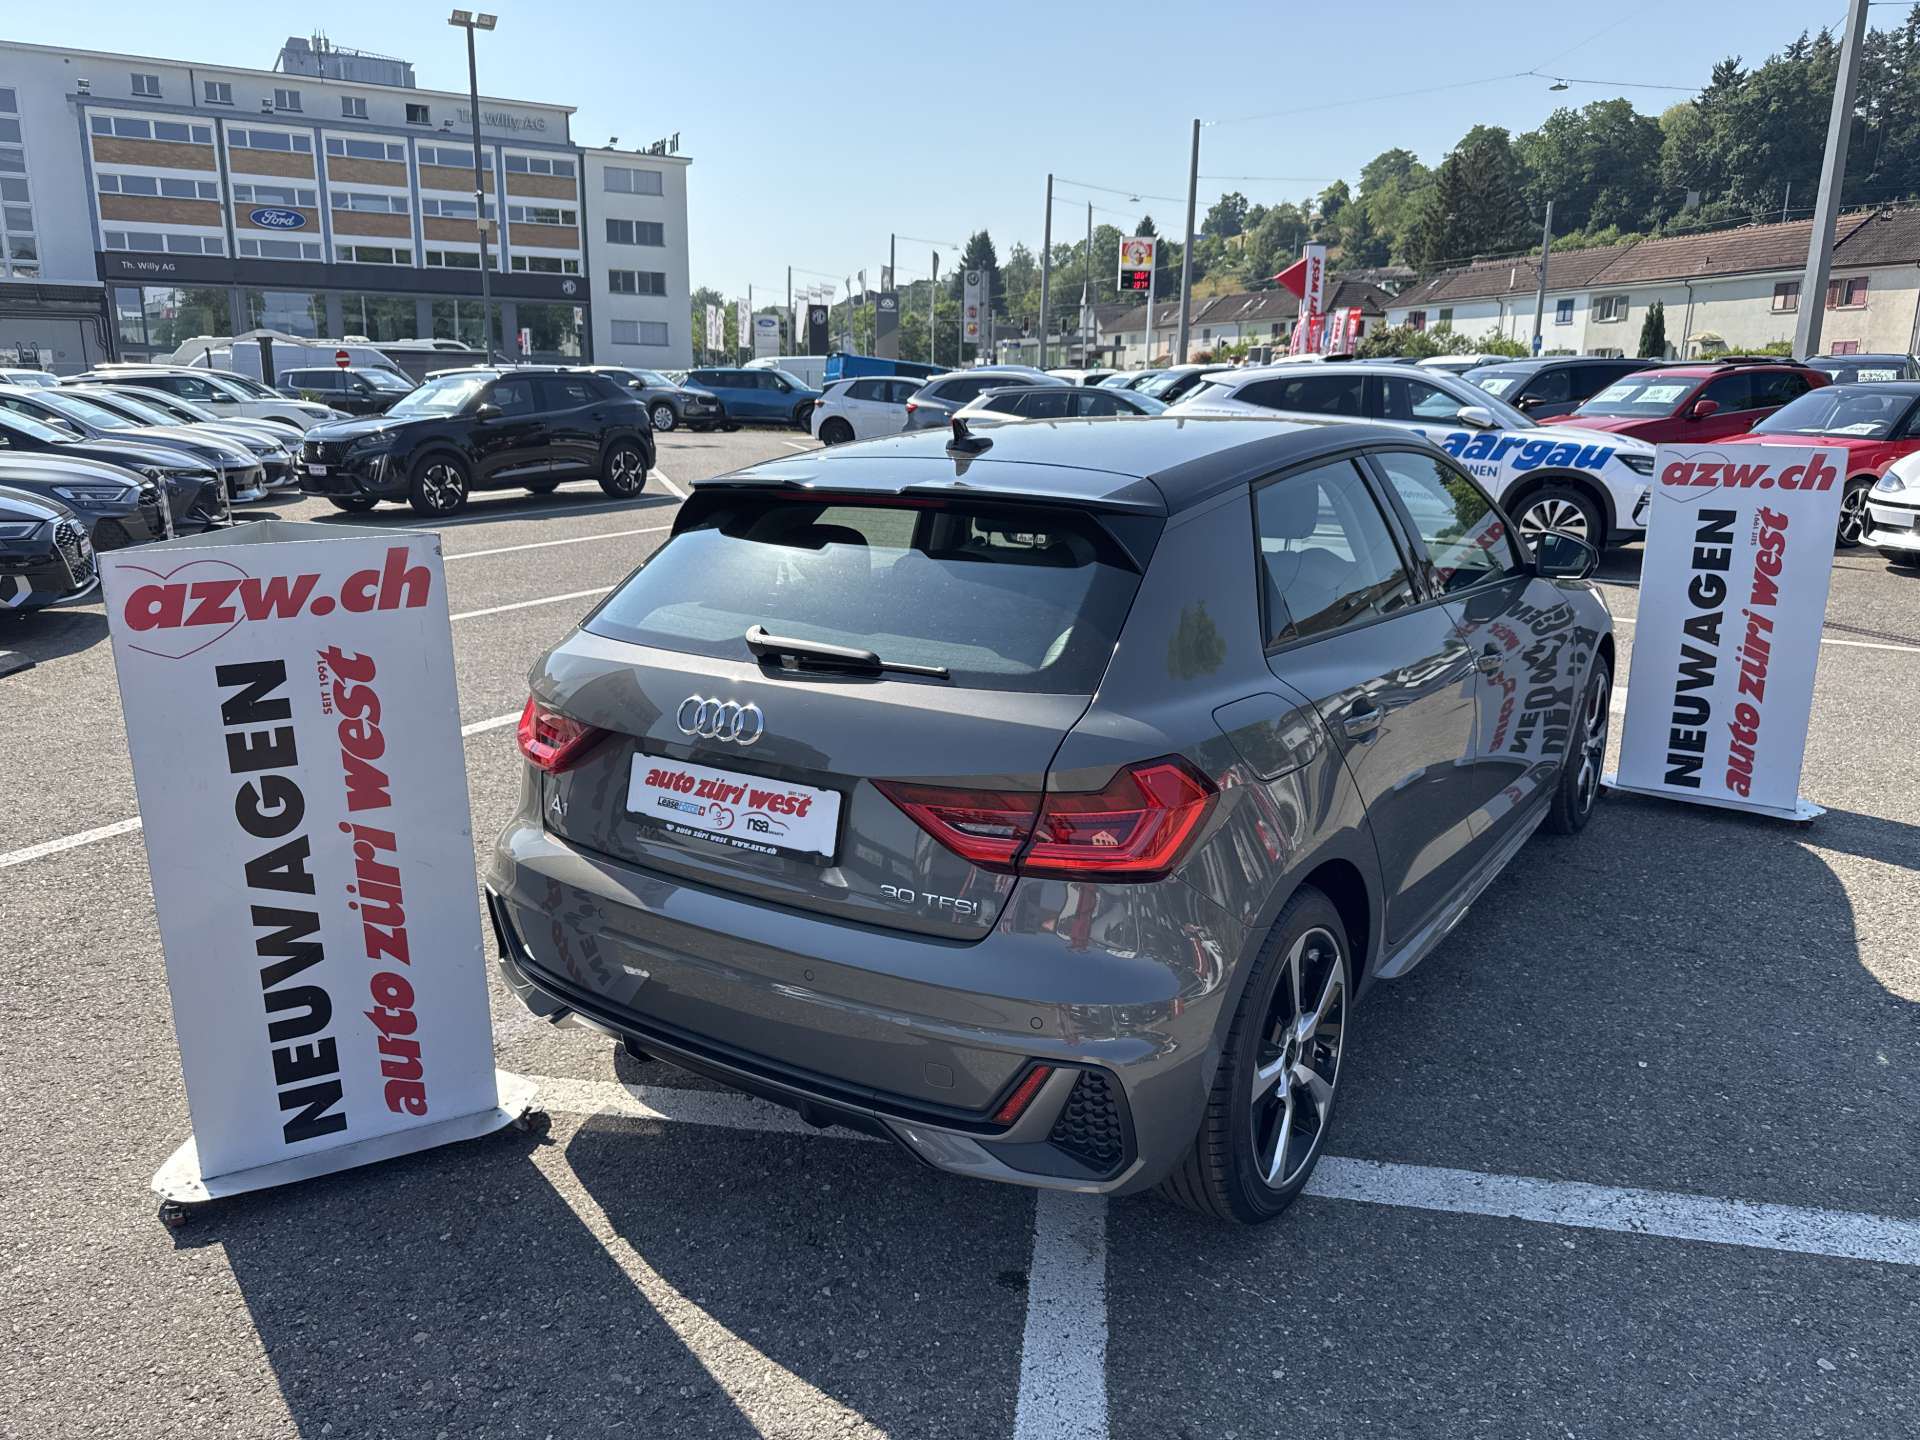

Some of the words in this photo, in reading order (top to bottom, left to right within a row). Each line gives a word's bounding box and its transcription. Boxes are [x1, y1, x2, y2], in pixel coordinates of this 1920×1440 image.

[260, 209, 295, 227] Ford
[121, 261, 136, 270] Th.
[137, 262, 160, 272] Willy
[162, 263, 176, 271] AG
[1442, 432, 1616, 470] aargau
[1661, 454, 1837, 490] azw.ch
[1751, 506, 1789, 607] west
[124, 547, 431, 631] azw.ch
[1664, 509, 1737, 788] NEUWAGEN
[1735, 608, 1777, 704] züri
[317, 661, 328, 687] 1991
[317, 644, 392, 812] west
[321, 692, 333, 714] SEIT
[1726, 703, 1760, 798] auto
[645, 767, 696, 793] auto
[693, 778, 748, 805] züri
[748, 789, 812, 817] west
[676, 826, 692, 836] auto
[710, 834, 728, 845] west
[731, 839, 778, 855] www.azw.ch
[747, 818, 769, 833] nsa
[214, 659, 348, 1146] NEUWAGEN
[339, 821, 411, 966] züri
[880, 884, 915, 903] 30
[921, 892, 978, 916] TFSI
[363, 972, 428, 1116] auto
